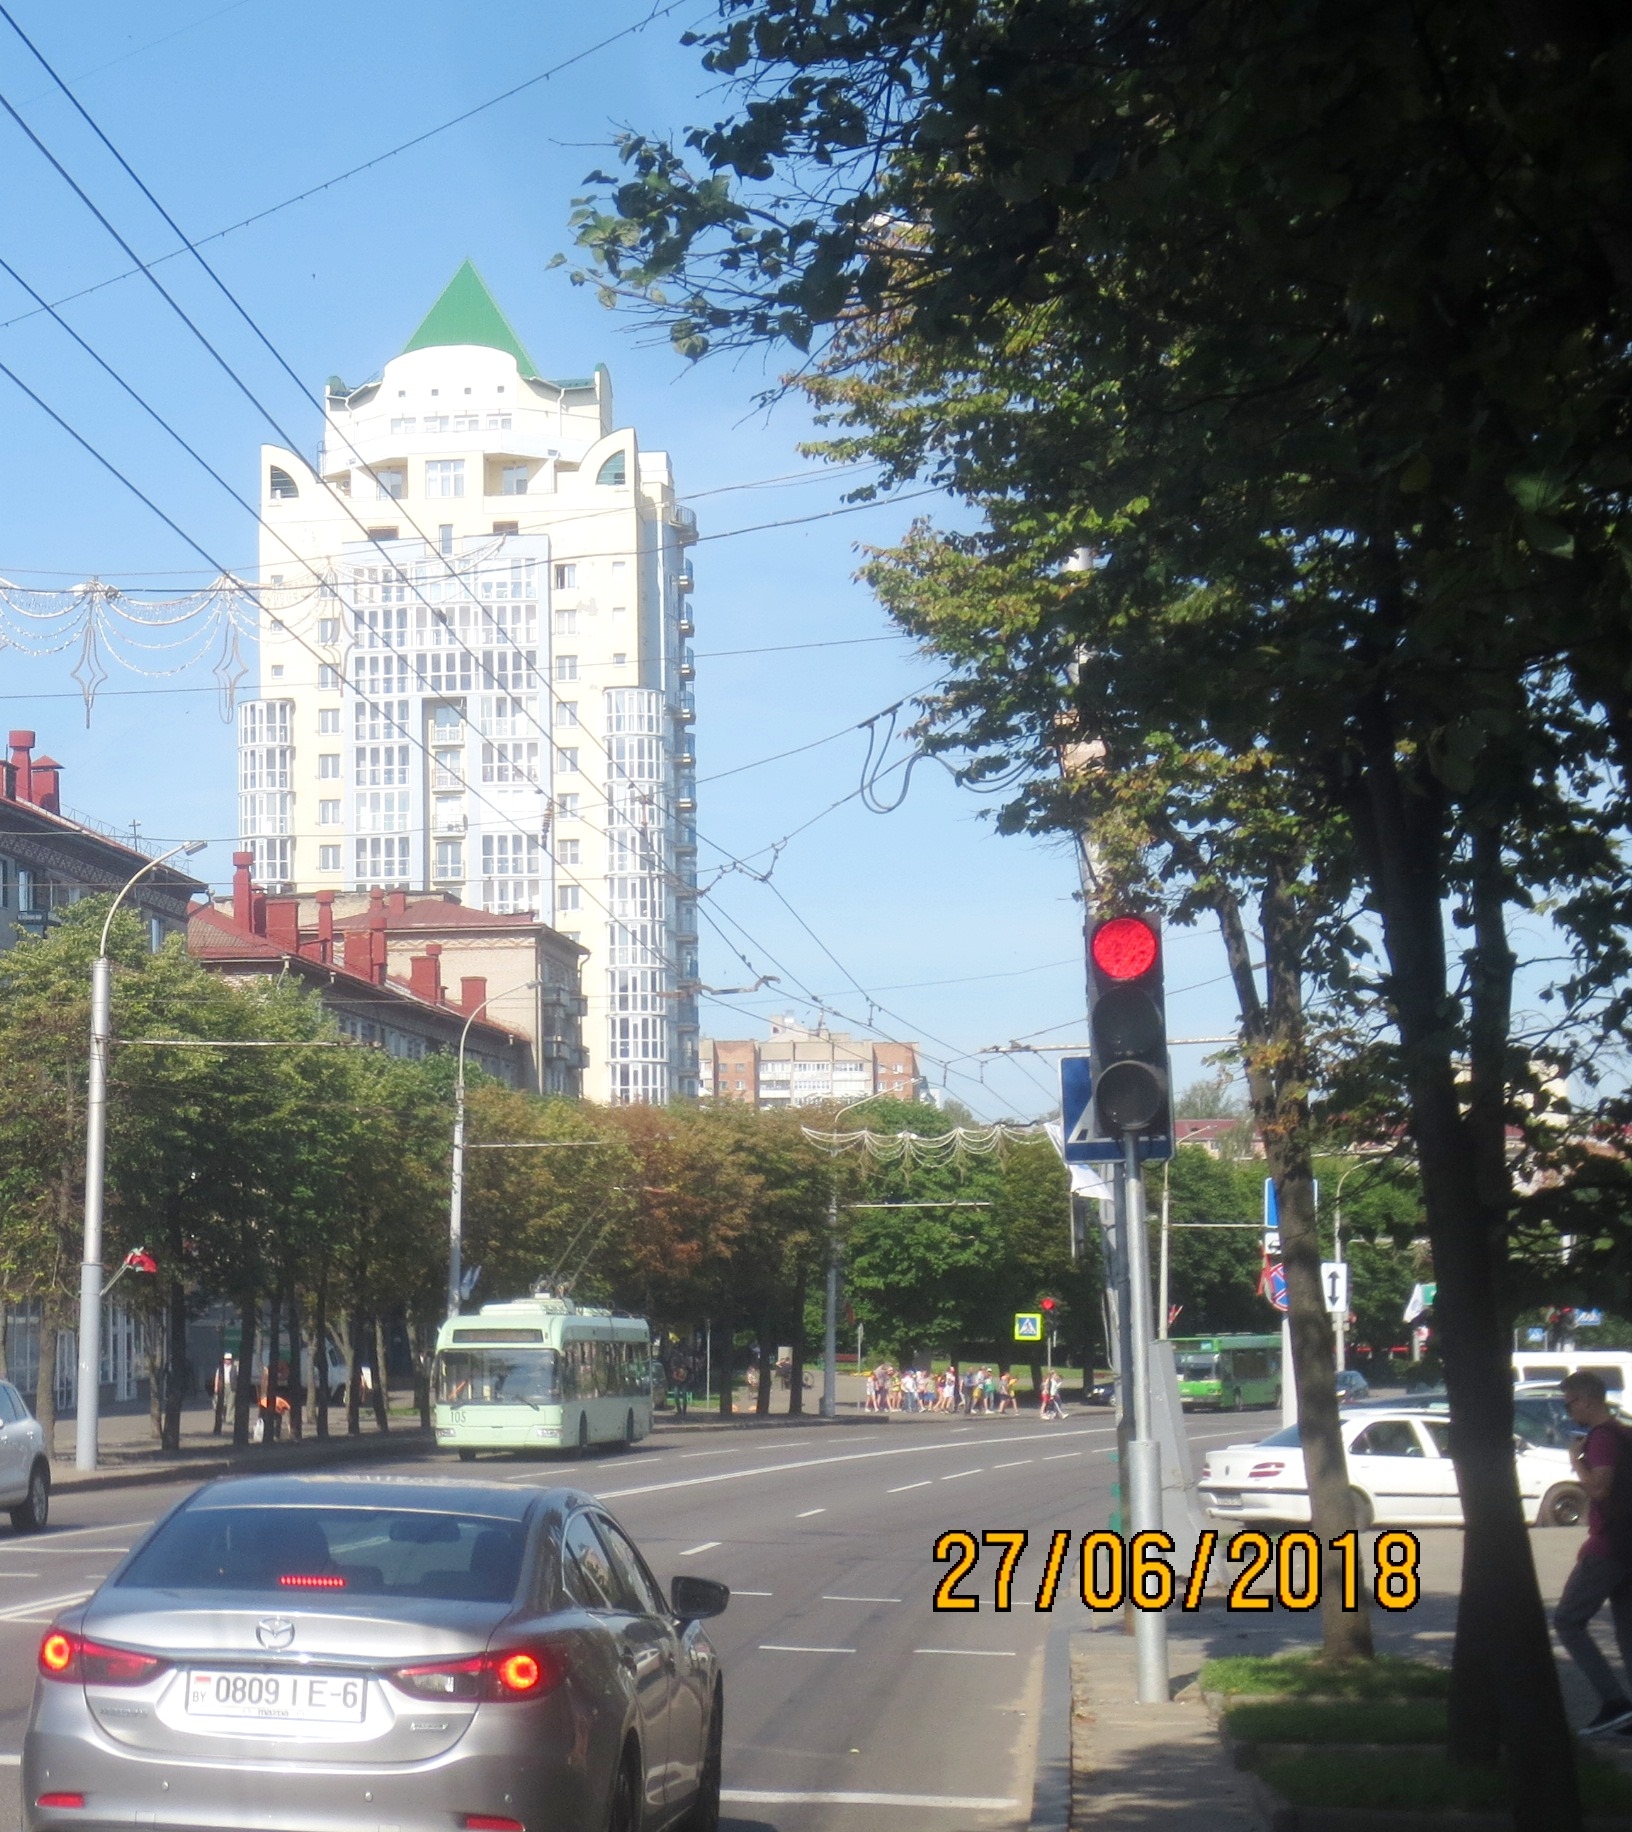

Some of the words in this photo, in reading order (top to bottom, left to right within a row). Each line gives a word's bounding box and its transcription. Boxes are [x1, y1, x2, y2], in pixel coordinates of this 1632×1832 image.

[451, 1411, 466, 1423] 105
[215, 1676, 280, 1704] 0809
[257, 1708, 289, 1717] mazda
